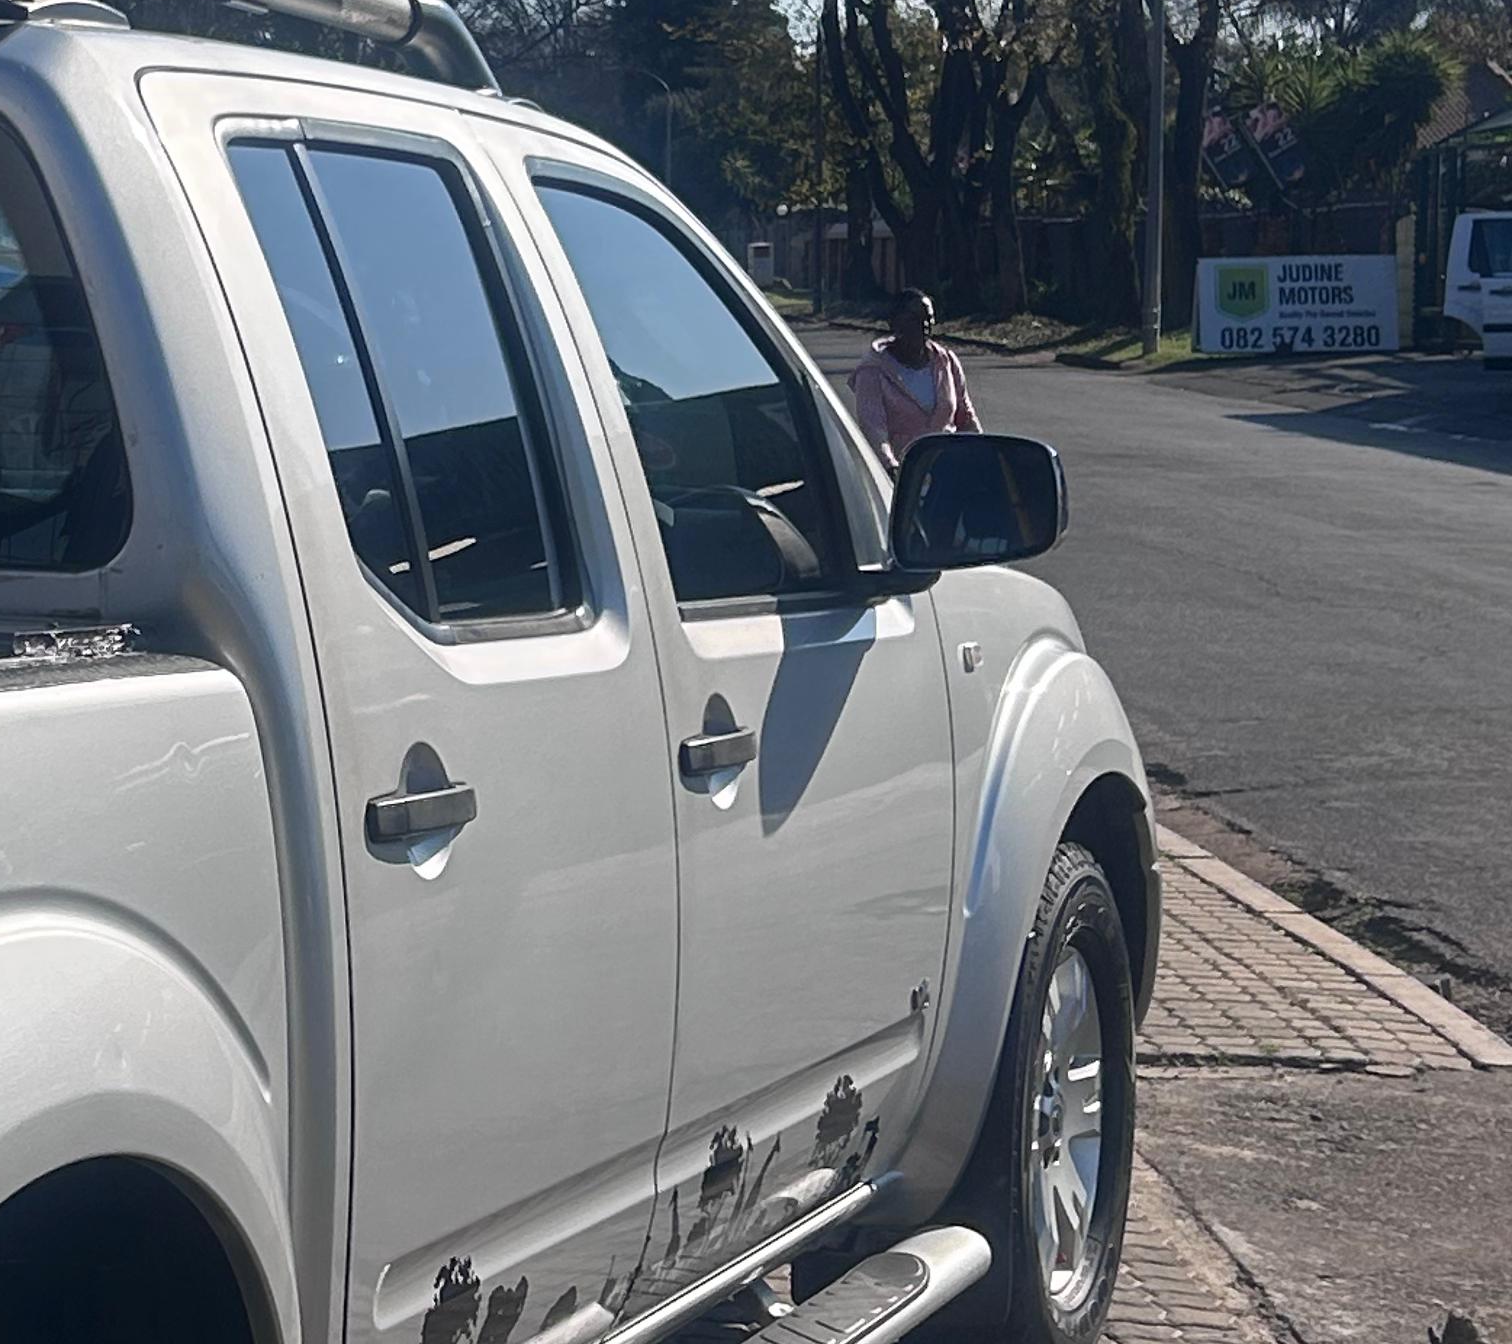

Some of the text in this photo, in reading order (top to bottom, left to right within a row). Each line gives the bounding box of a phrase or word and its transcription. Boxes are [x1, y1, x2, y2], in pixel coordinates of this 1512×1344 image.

[1277, 263, 1344, 283] JUDINE
[1227, 280, 1256, 301] JM
[1279, 286, 1354, 306] MOTORS
[1221, 325, 1380, 349] 082 574 3280
